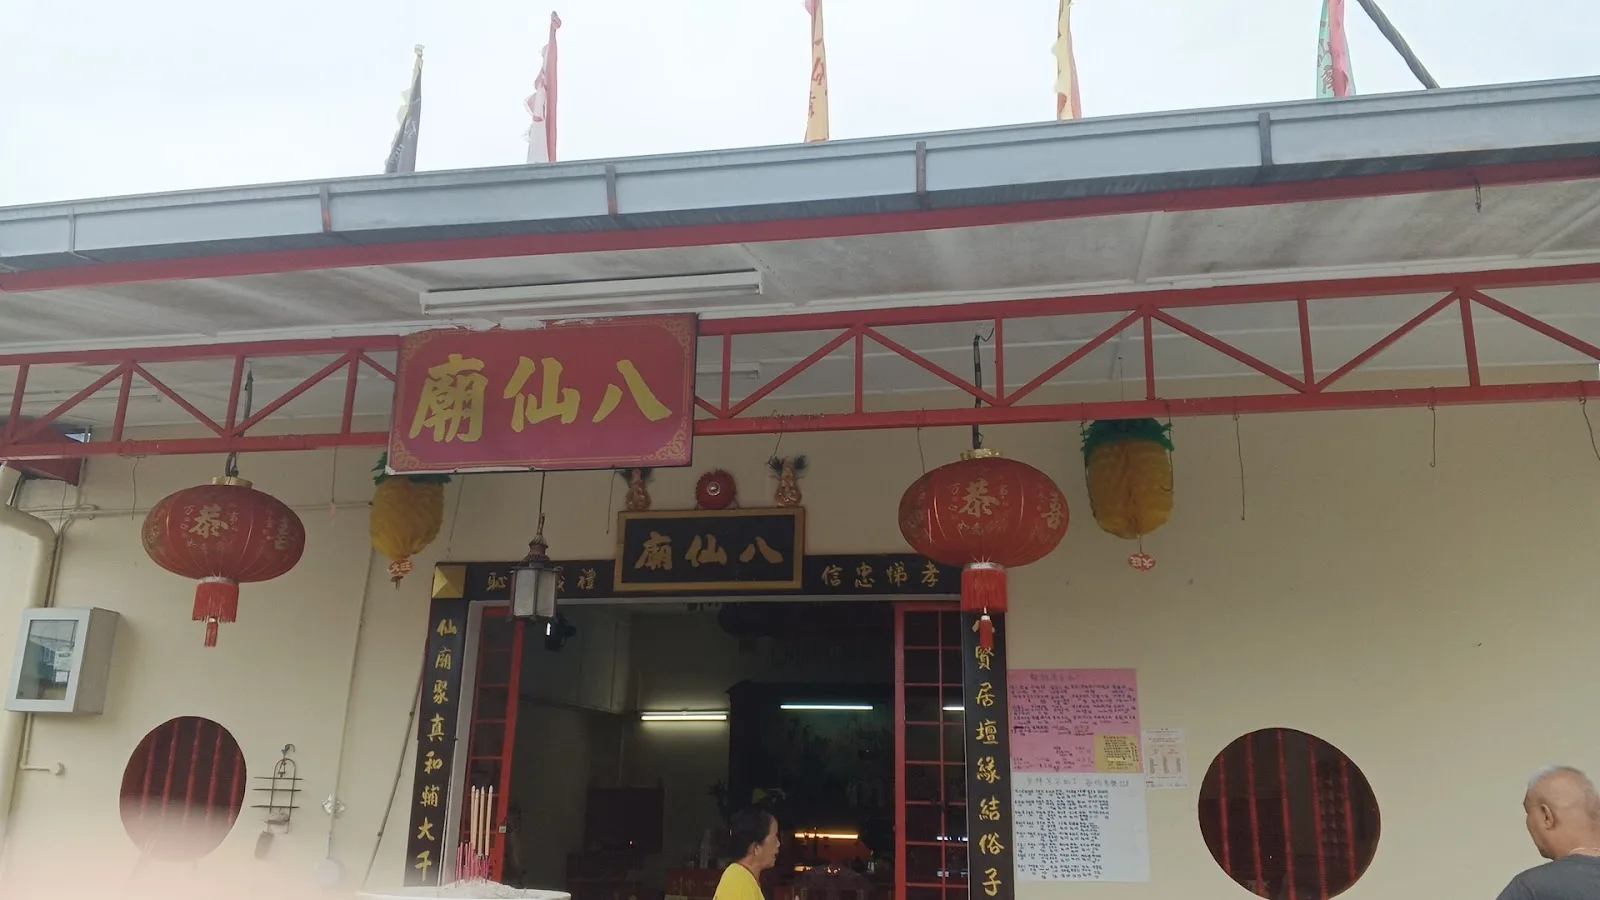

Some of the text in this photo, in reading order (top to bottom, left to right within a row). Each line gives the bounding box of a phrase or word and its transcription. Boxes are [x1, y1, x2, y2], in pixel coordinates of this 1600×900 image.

[409, 352, 673, 443] 八仙廟
[634, 530, 784, 571] 八仙廟
[486, 567, 597, 592] 禮恥
[821, 560, 940, 588] 孝悌忠信
[971, 619, 1005, 897] 賢居壇緣結俗子
